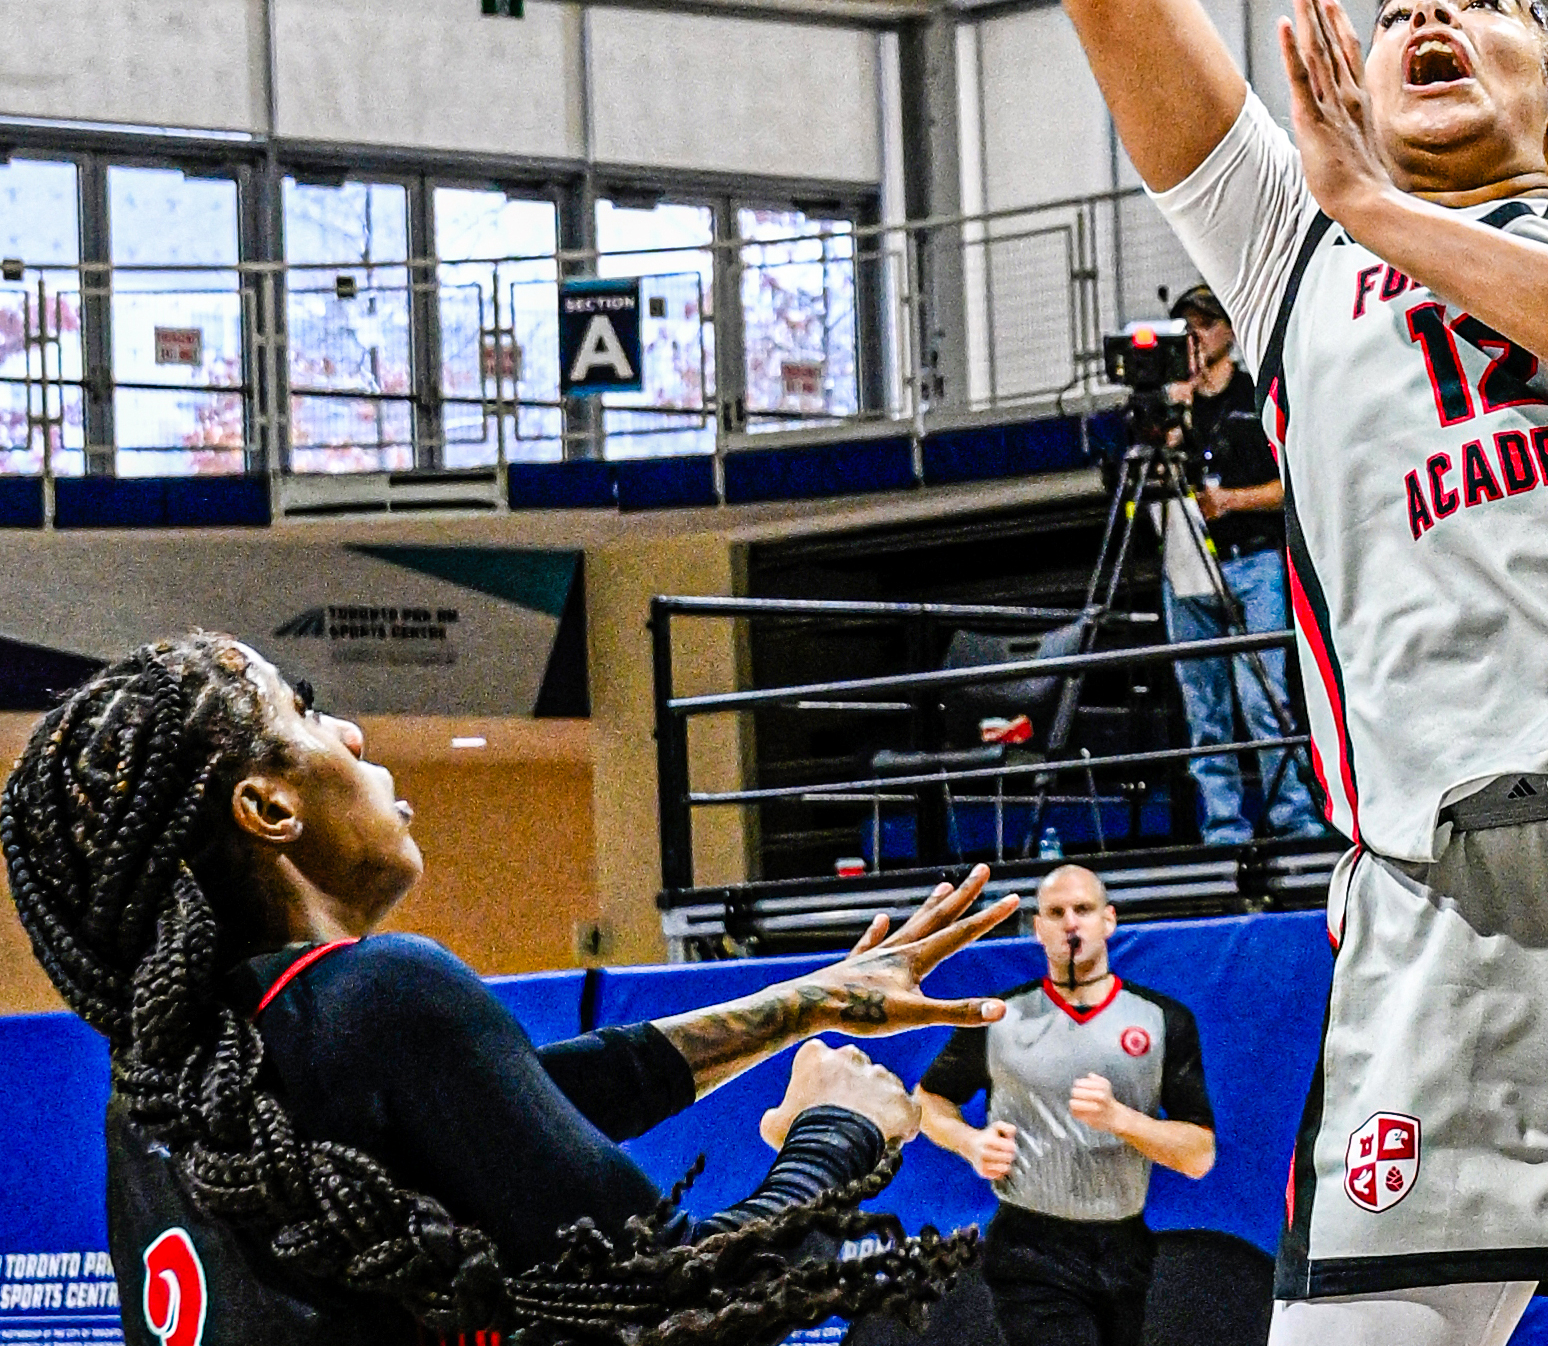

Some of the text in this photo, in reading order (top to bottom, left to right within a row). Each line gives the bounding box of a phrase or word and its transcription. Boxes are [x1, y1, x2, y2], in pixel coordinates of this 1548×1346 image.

[564, 295, 635, 312] SECTION
[569, 314, 634, 382] A
[1405, 301, 1547, 428] 12
[6, 1252, 81, 1279] TORONTO
[0, 1281, 121, 1310] SPORTS CENTR
